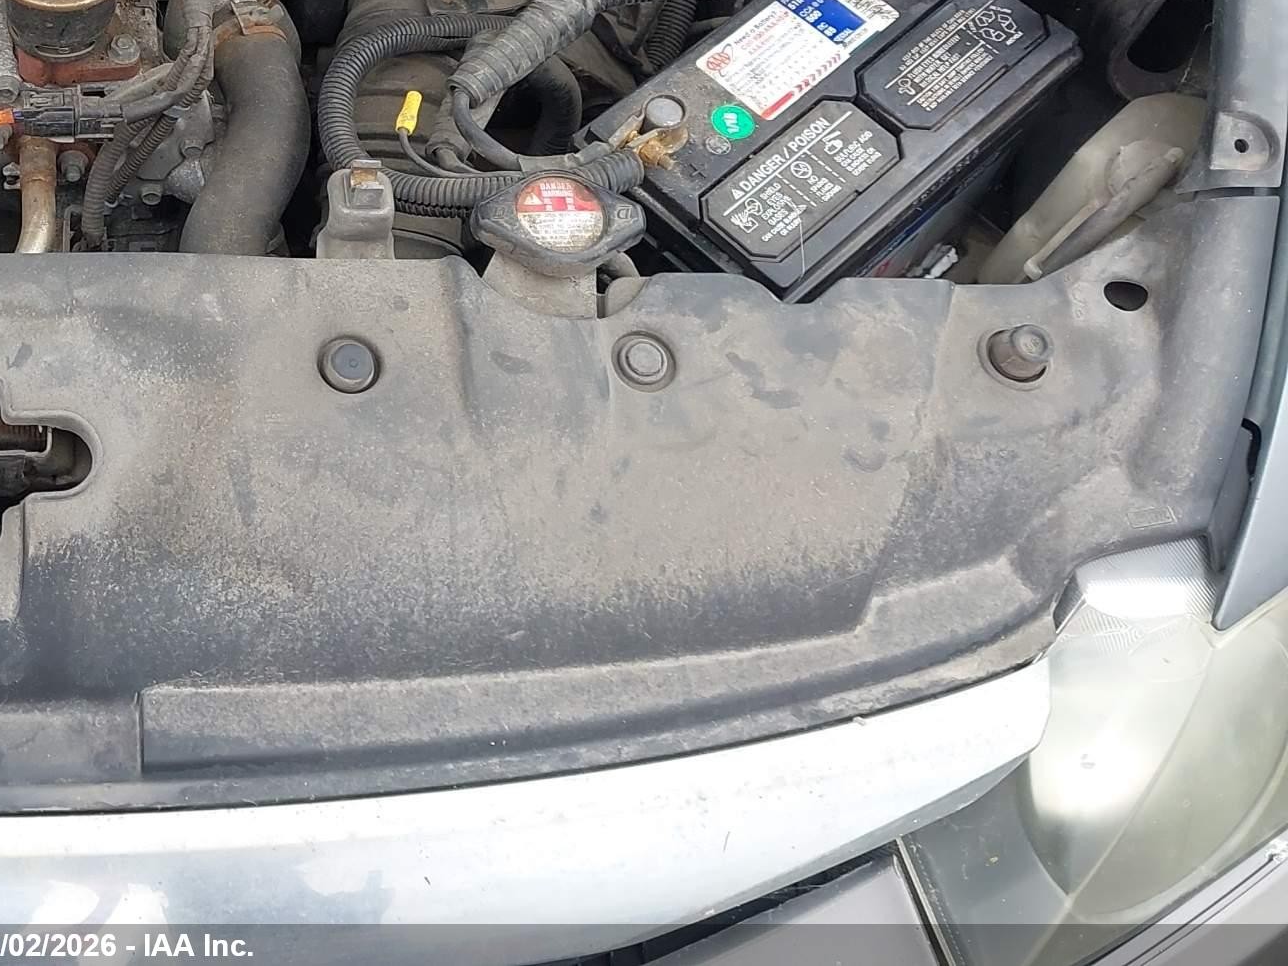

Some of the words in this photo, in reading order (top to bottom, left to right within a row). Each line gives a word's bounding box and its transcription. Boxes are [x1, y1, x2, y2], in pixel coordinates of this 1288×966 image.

[799, 5, 814, 18] CCA
[734, 32, 751, 45] Need
[858, 130, 874, 144] ACID
[739, 154, 786, 192] DANGER
[787, 117, 831, 152] POISON
[807, 175, 819, 185] NO
[760, 183, 781, 200] SHIELD
[767, 192, 783, 205] EYES
[767, 209, 789, 226] GASES
